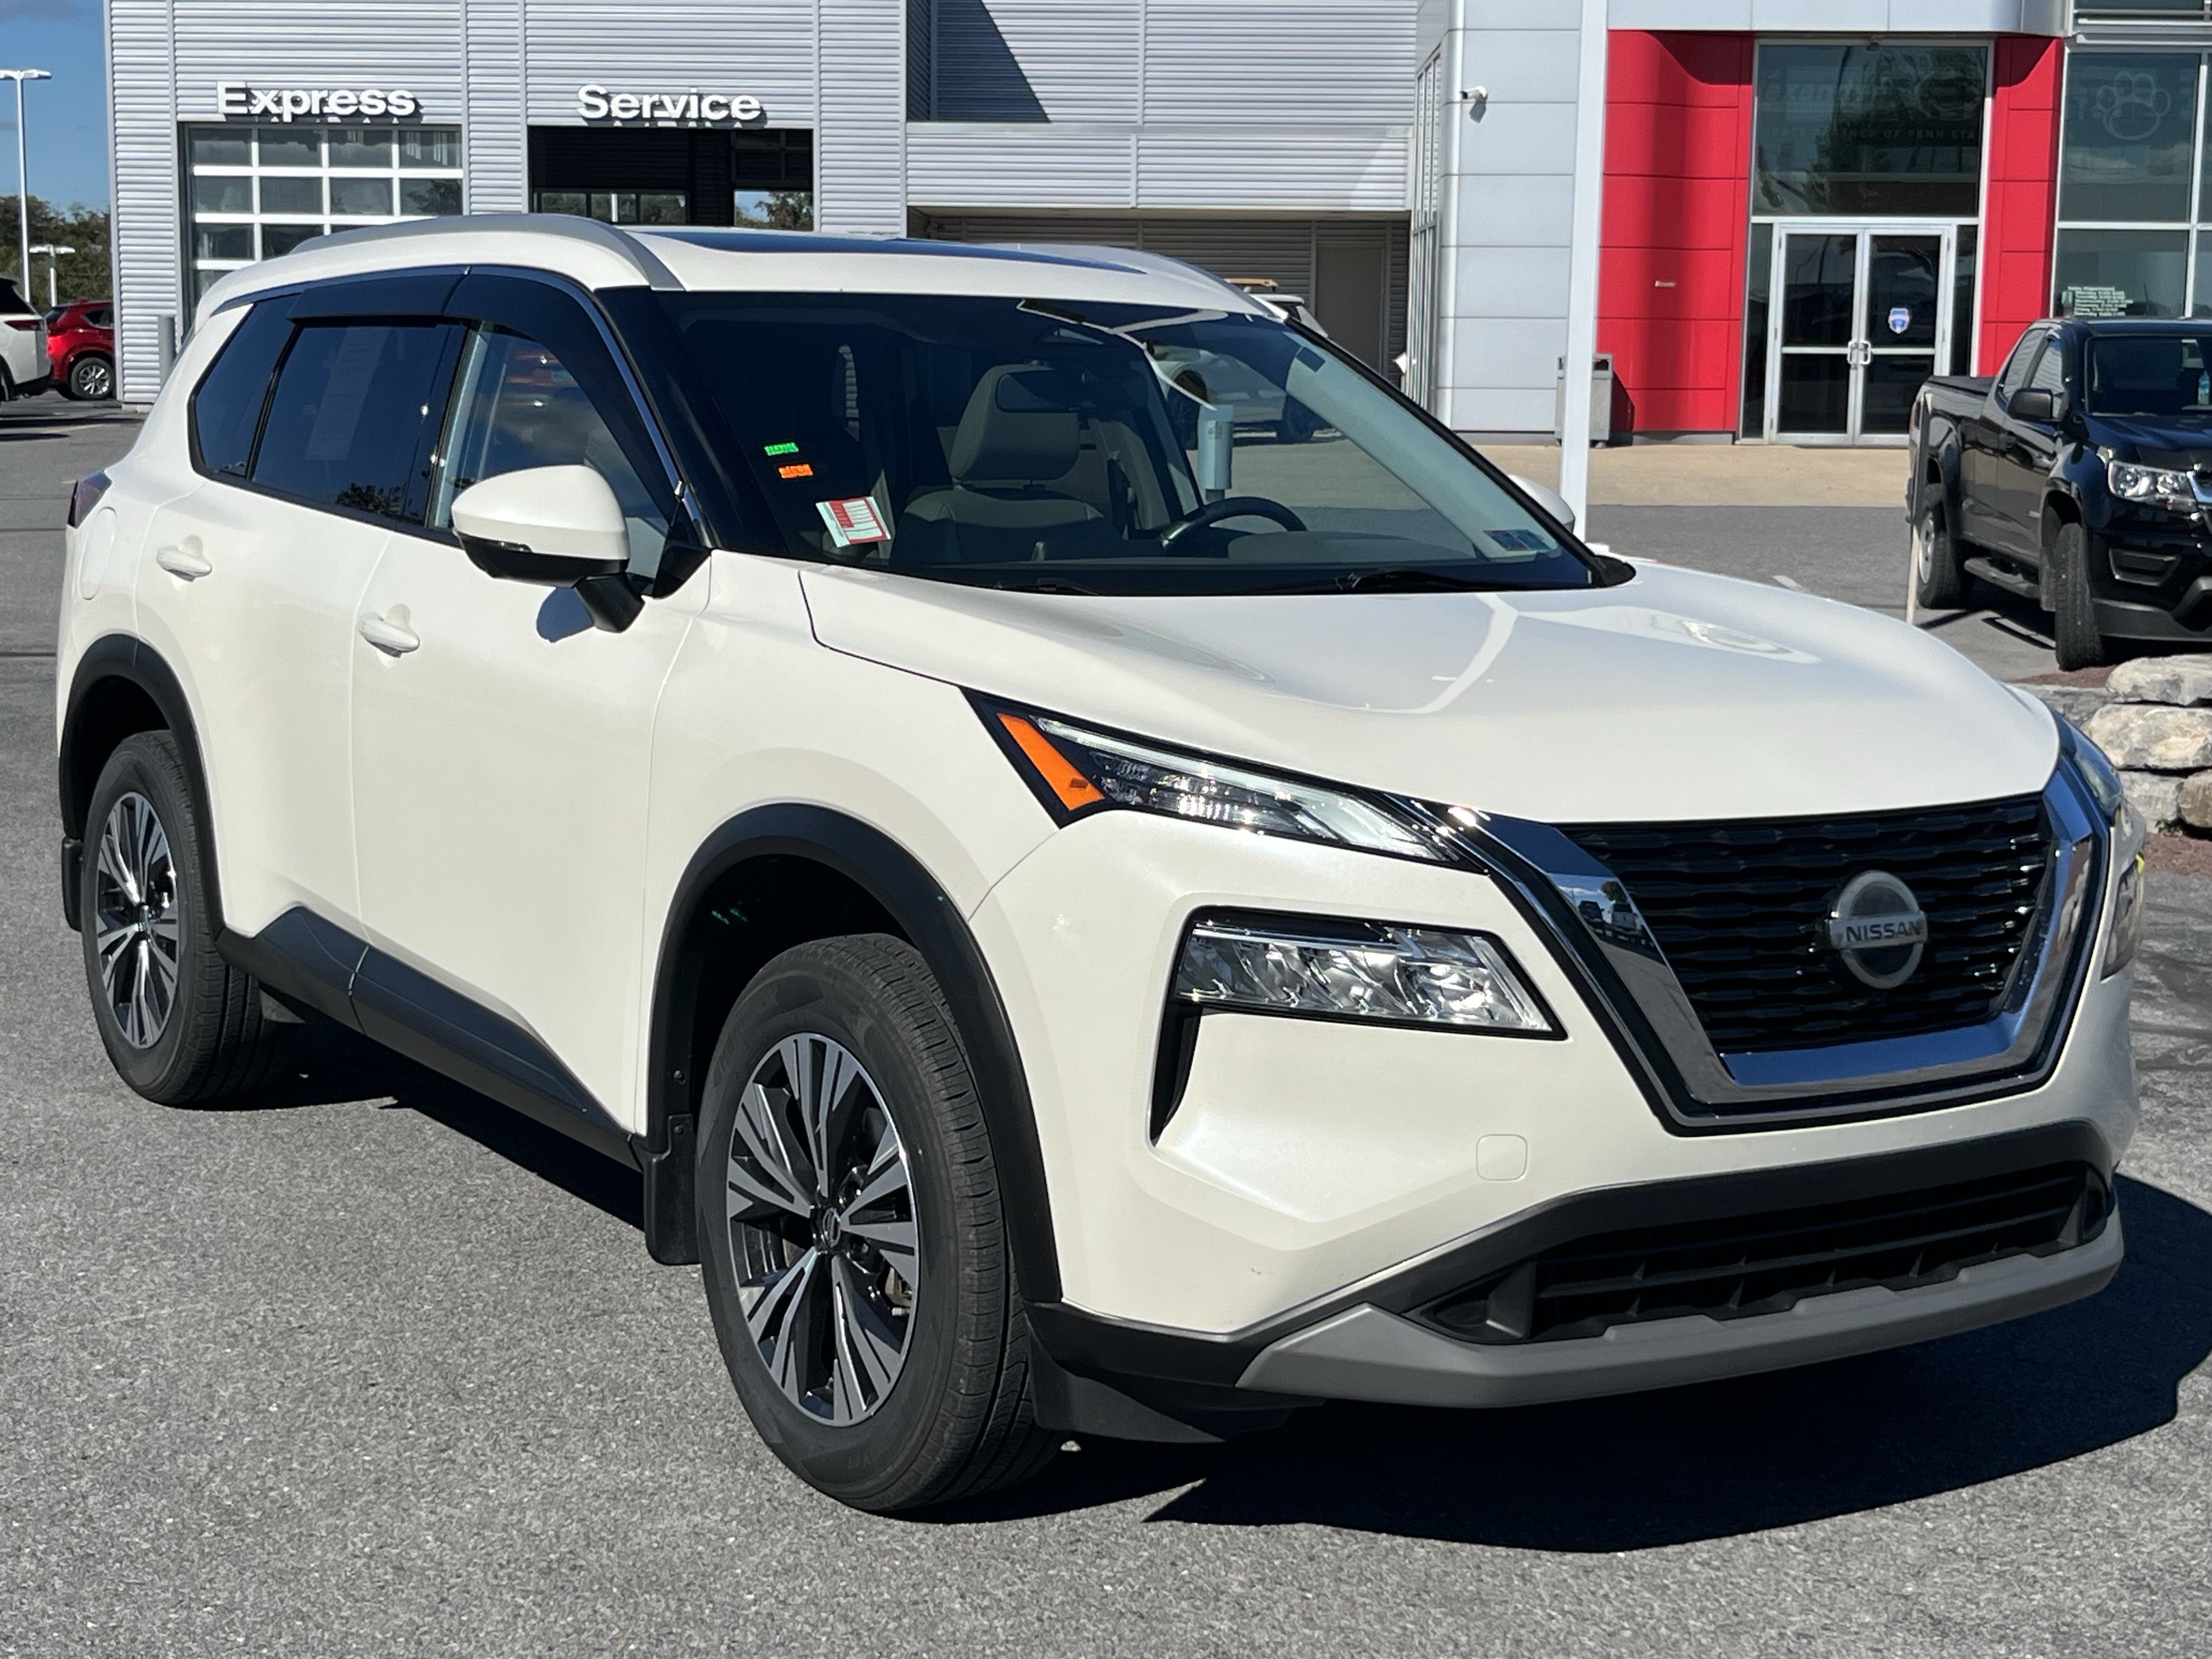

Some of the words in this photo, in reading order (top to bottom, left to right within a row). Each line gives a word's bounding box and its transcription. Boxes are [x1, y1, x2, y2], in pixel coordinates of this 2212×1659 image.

[217, 82, 415, 122] Express
[578, 84, 761, 120] Service
[1846, 921, 1923, 943] NISSAN
